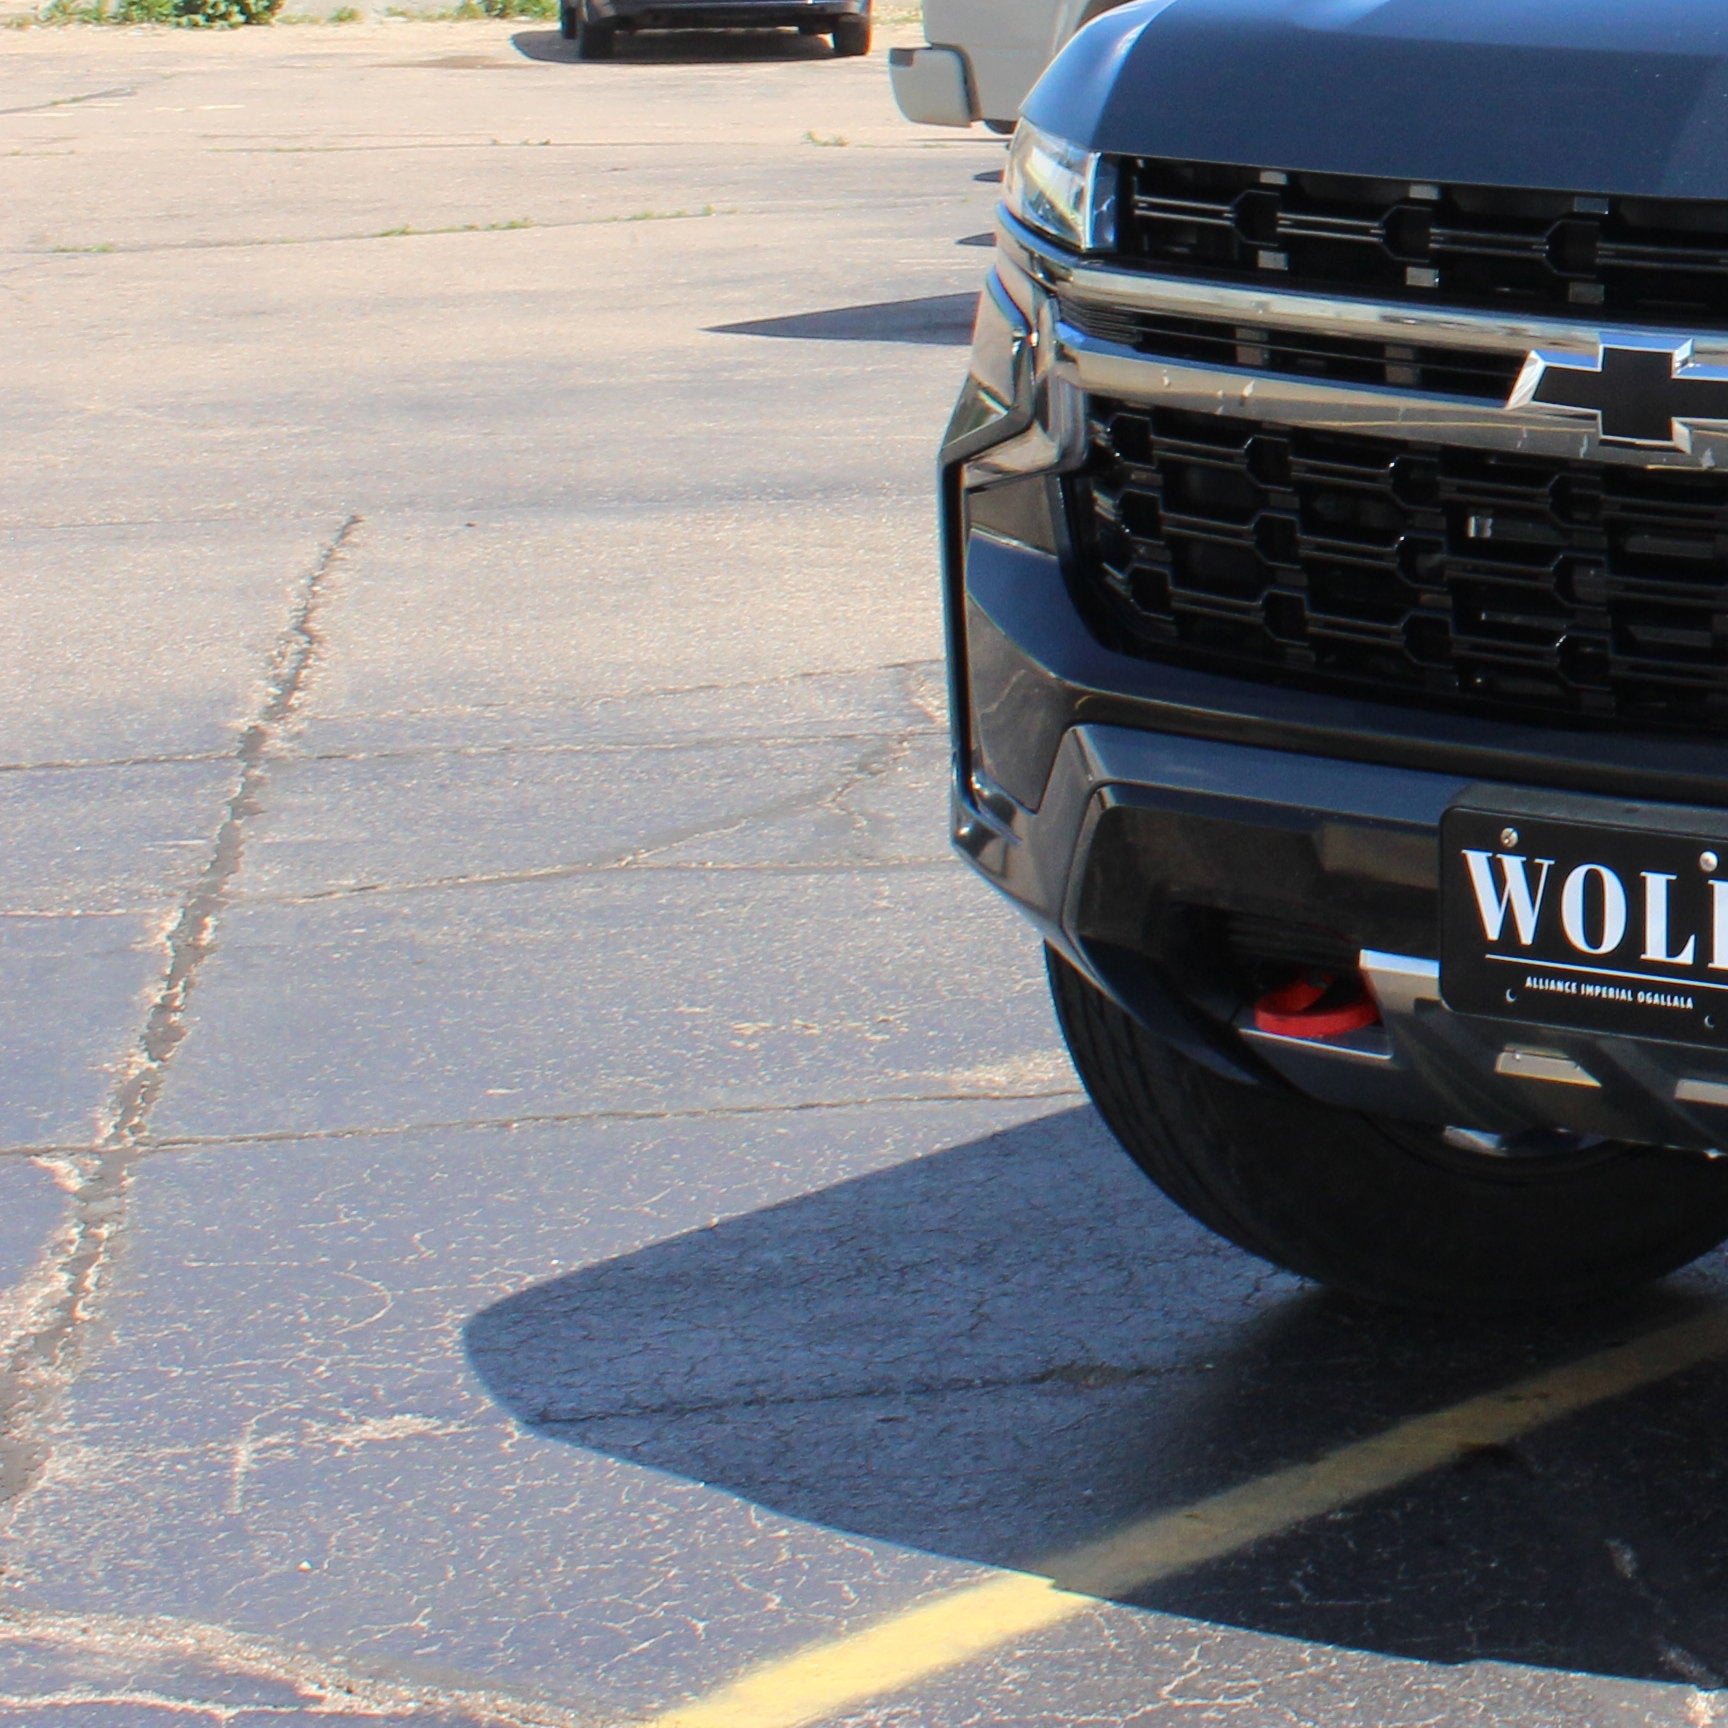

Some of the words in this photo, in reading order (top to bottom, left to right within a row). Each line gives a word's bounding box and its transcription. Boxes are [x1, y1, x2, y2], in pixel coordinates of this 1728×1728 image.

[1524, 975, 1578, 994] ALLIANCE
[1580, 983, 1634, 1002] IMPERIAL
[1637, 991, 1694, 1010] OGALLALA
